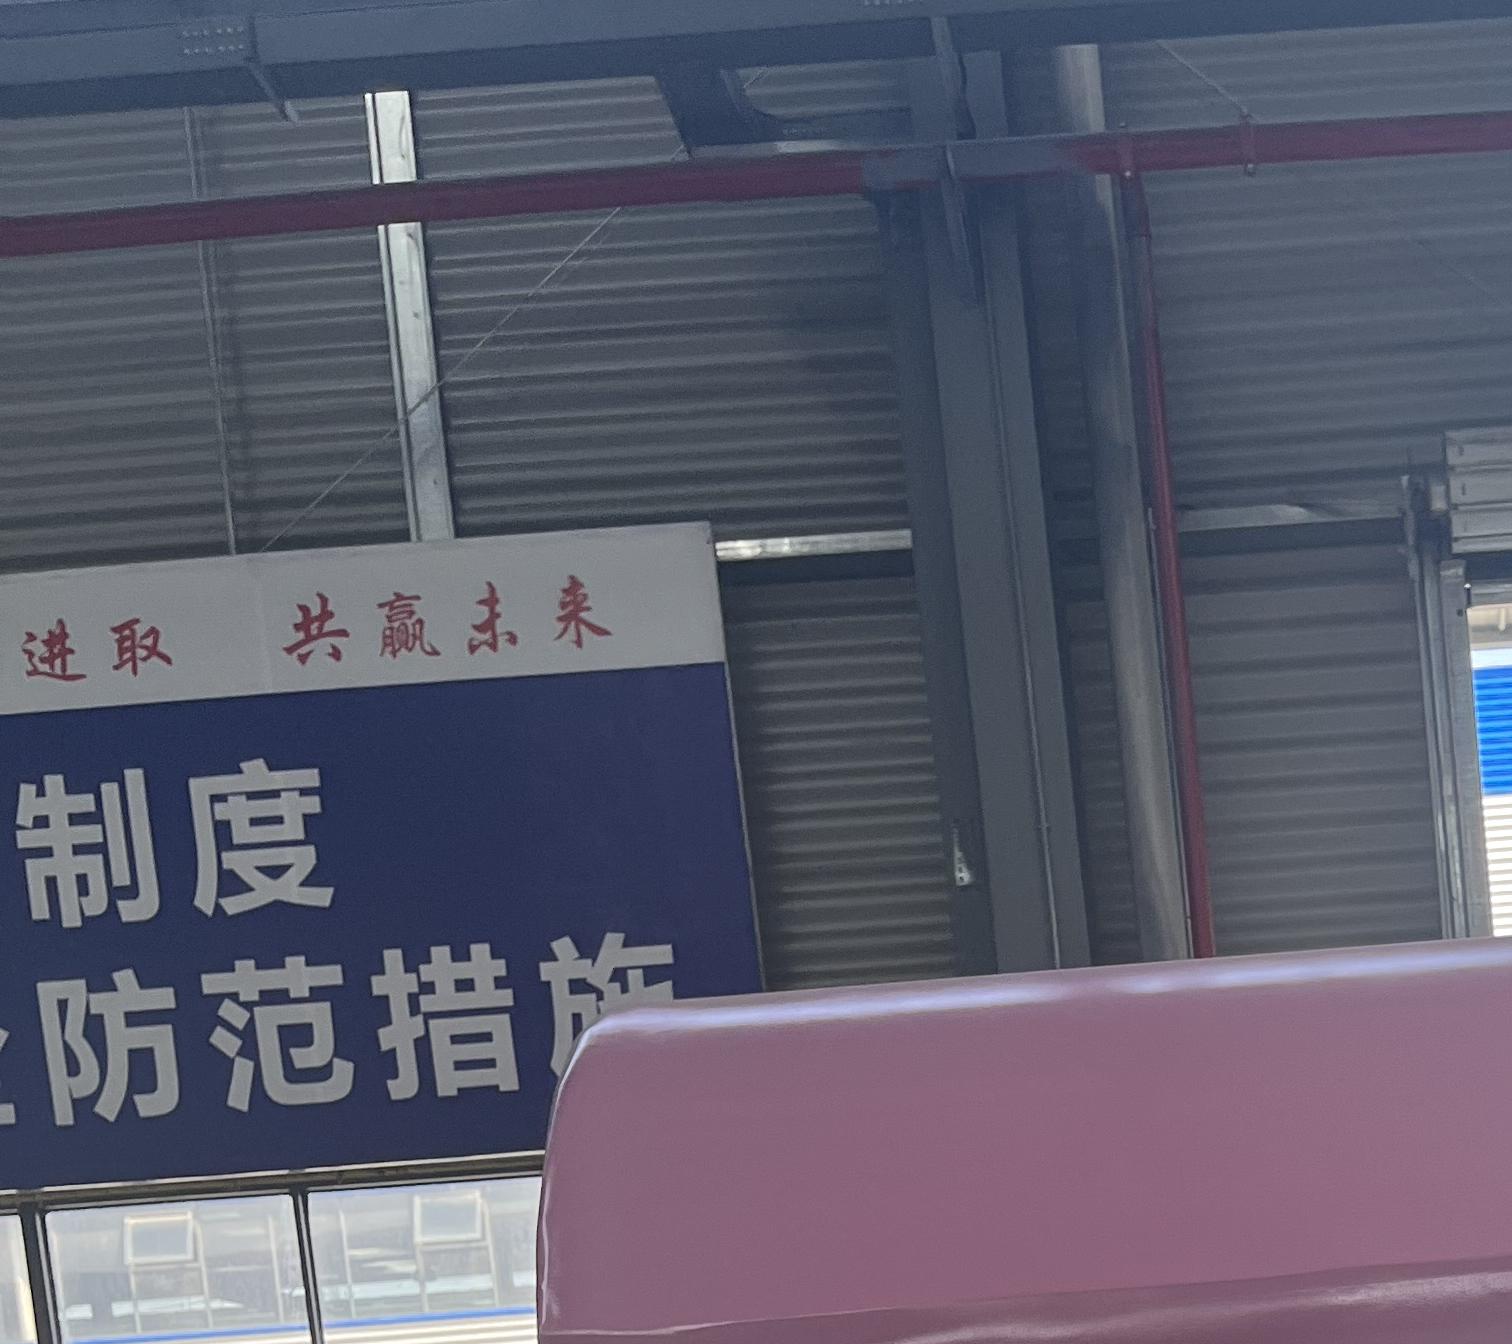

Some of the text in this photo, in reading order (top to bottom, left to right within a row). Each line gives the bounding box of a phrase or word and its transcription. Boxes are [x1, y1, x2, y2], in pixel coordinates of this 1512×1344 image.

[22, 574, 612, 682] 进取 共赢未来
[15, 757, 335, 929] 制度
